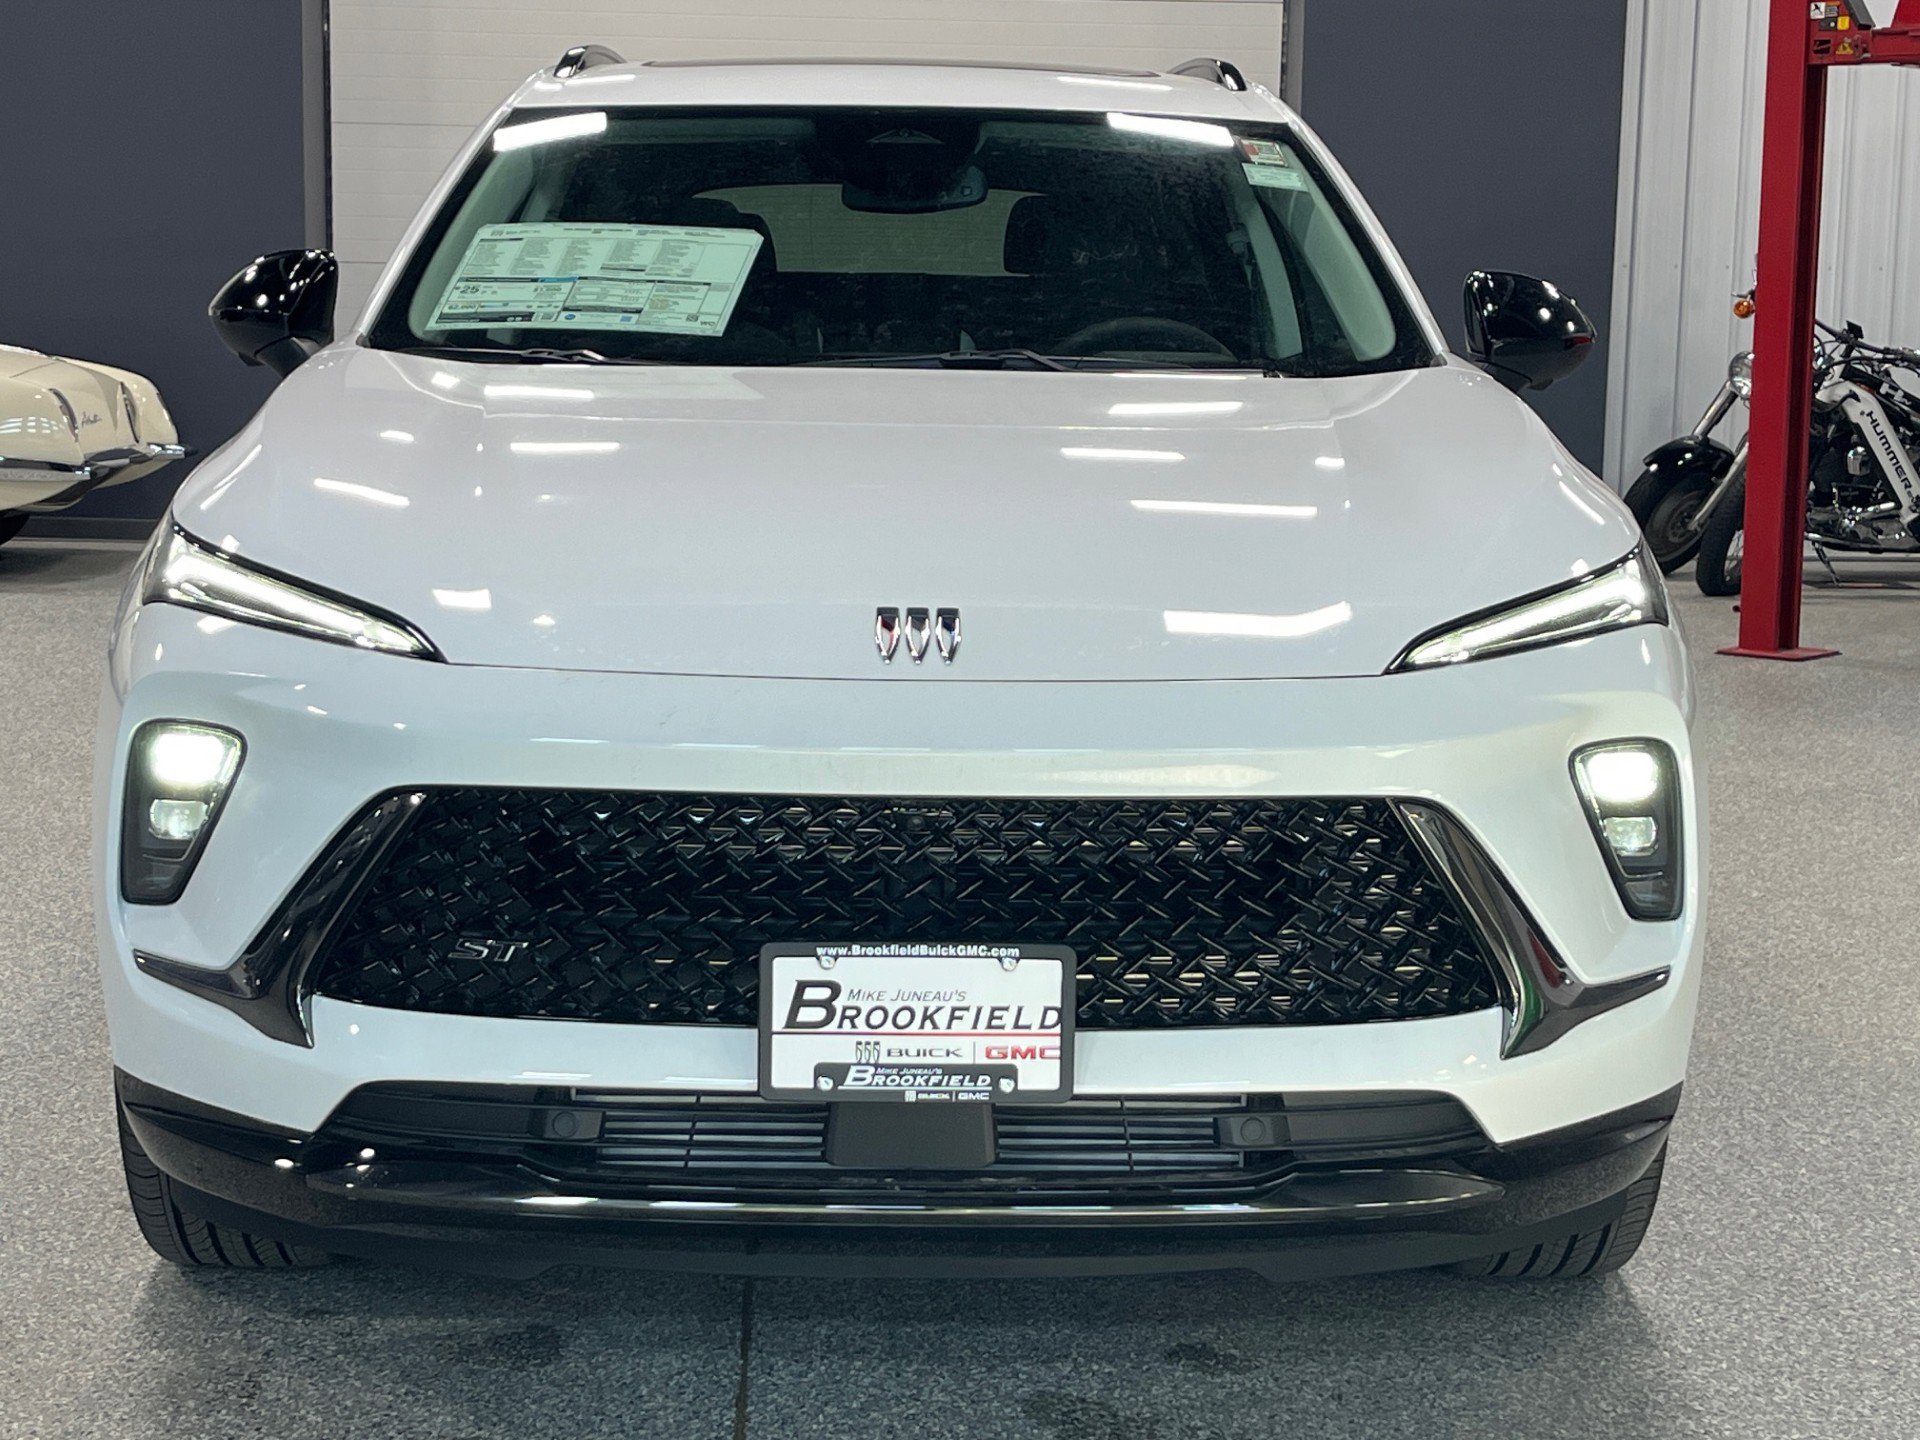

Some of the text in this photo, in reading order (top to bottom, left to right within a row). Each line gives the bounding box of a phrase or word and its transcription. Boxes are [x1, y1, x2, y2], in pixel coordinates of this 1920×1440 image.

[1865, 410, 1912, 490] HUMMER
[447, 938, 530, 963] ST
[815, 944, 1020, 957] www.BrookfieldBuickGMC.com
[847, 988, 967, 1002] MIKE JUNEAU'S
[781, 979, 1062, 1030] BROOKFIELD
[886, 1045, 1061, 1060] BUICK GMC
[843, 1065, 992, 1087] BROOKFIELD
[957, 1091, 990, 1100] GMC
